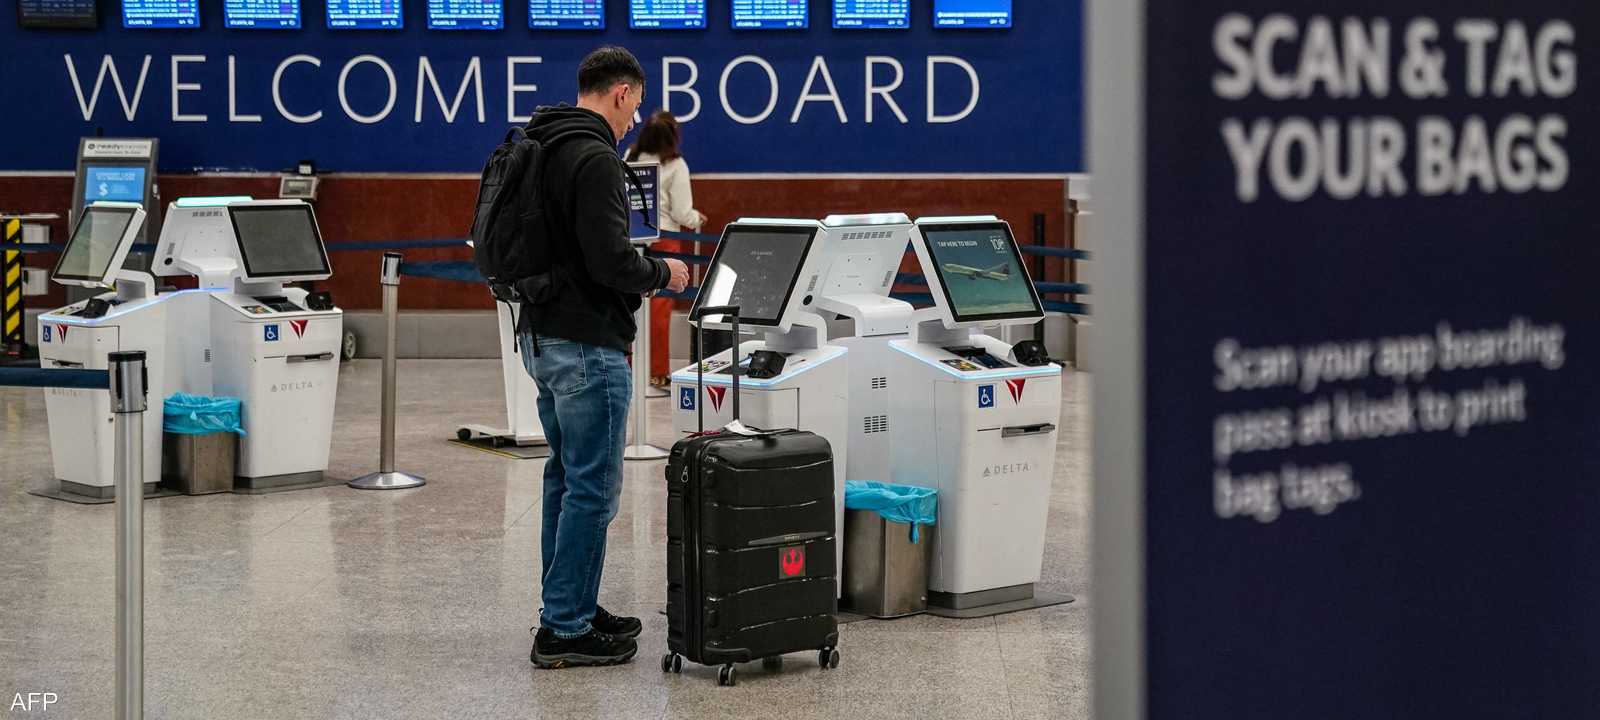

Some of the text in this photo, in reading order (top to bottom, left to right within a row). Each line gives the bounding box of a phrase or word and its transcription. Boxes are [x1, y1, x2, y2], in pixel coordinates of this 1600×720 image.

[64, 54, 981, 124] WELCOME BOARD
[1212, 13, 1578, 100] SCAN & TAG
[1220, 113, 1570, 203] YOUR BAGS
[281, 381, 312, 391] DELTA
[1214, 317, 1564, 392] Scan your app boarding
[1214, 378, 1526, 464] pass at kiosk to print
[994, 463, 1030, 474] DELTA
[1214, 462, 1361, 523] bag tags.
